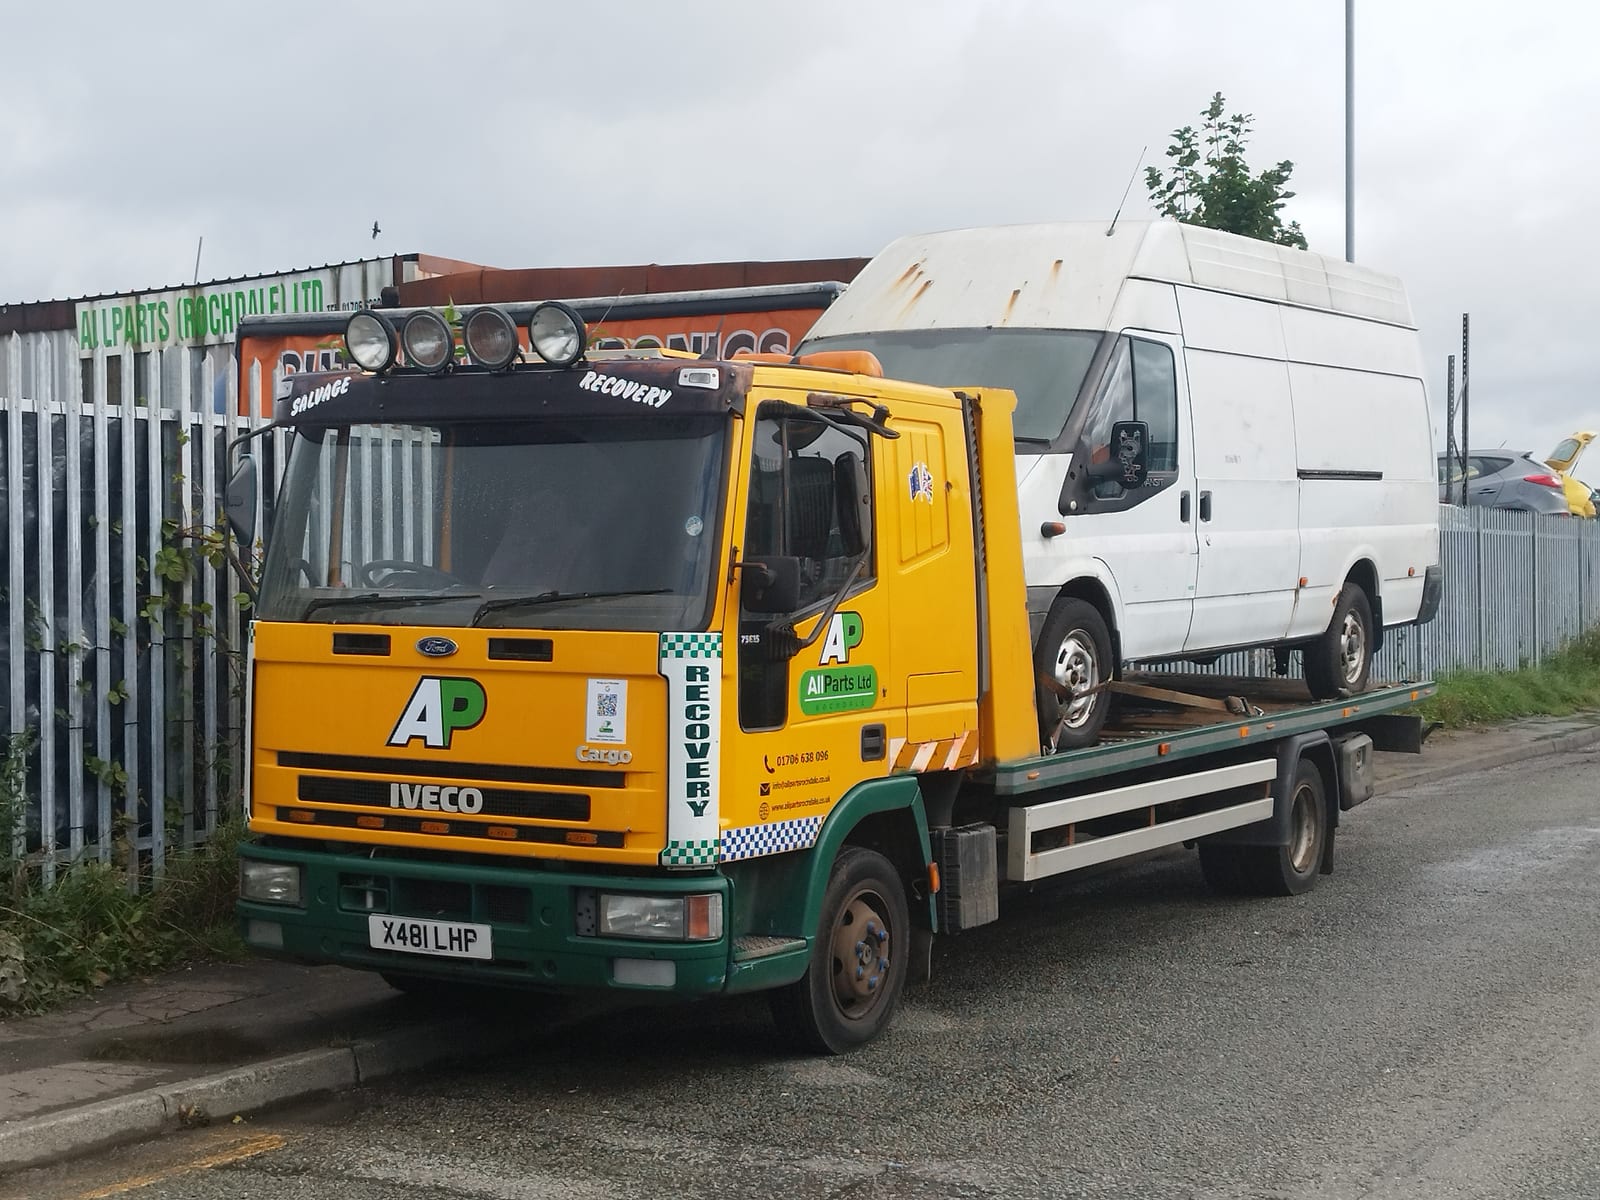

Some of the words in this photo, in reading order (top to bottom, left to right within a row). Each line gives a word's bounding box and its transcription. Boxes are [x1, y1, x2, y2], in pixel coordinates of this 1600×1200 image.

[80, 301, 170, 350] ALLPARTS
[290, 376, 352, 417] SALVAGE
[579, 370, 673, 409] RECOVERY
[819, 611, 864, 666] AP
[807, 673, 855, 696] AllParts
[857, 673, 872, 690] Ltd
[385, 675, 487, 750] AP
[576, 746, 633, 766] Cargo
[684, 665, 711, 818] RECOVERY
[776, 754, 799, 767] 01706
[800, 751, 814, 764] 638
[815, 749, 829, 761] 096
[389, 783, 483, 814] IVECO
[382, 920, 428, 949] X481
[433, 925, 478, 952] LHP
